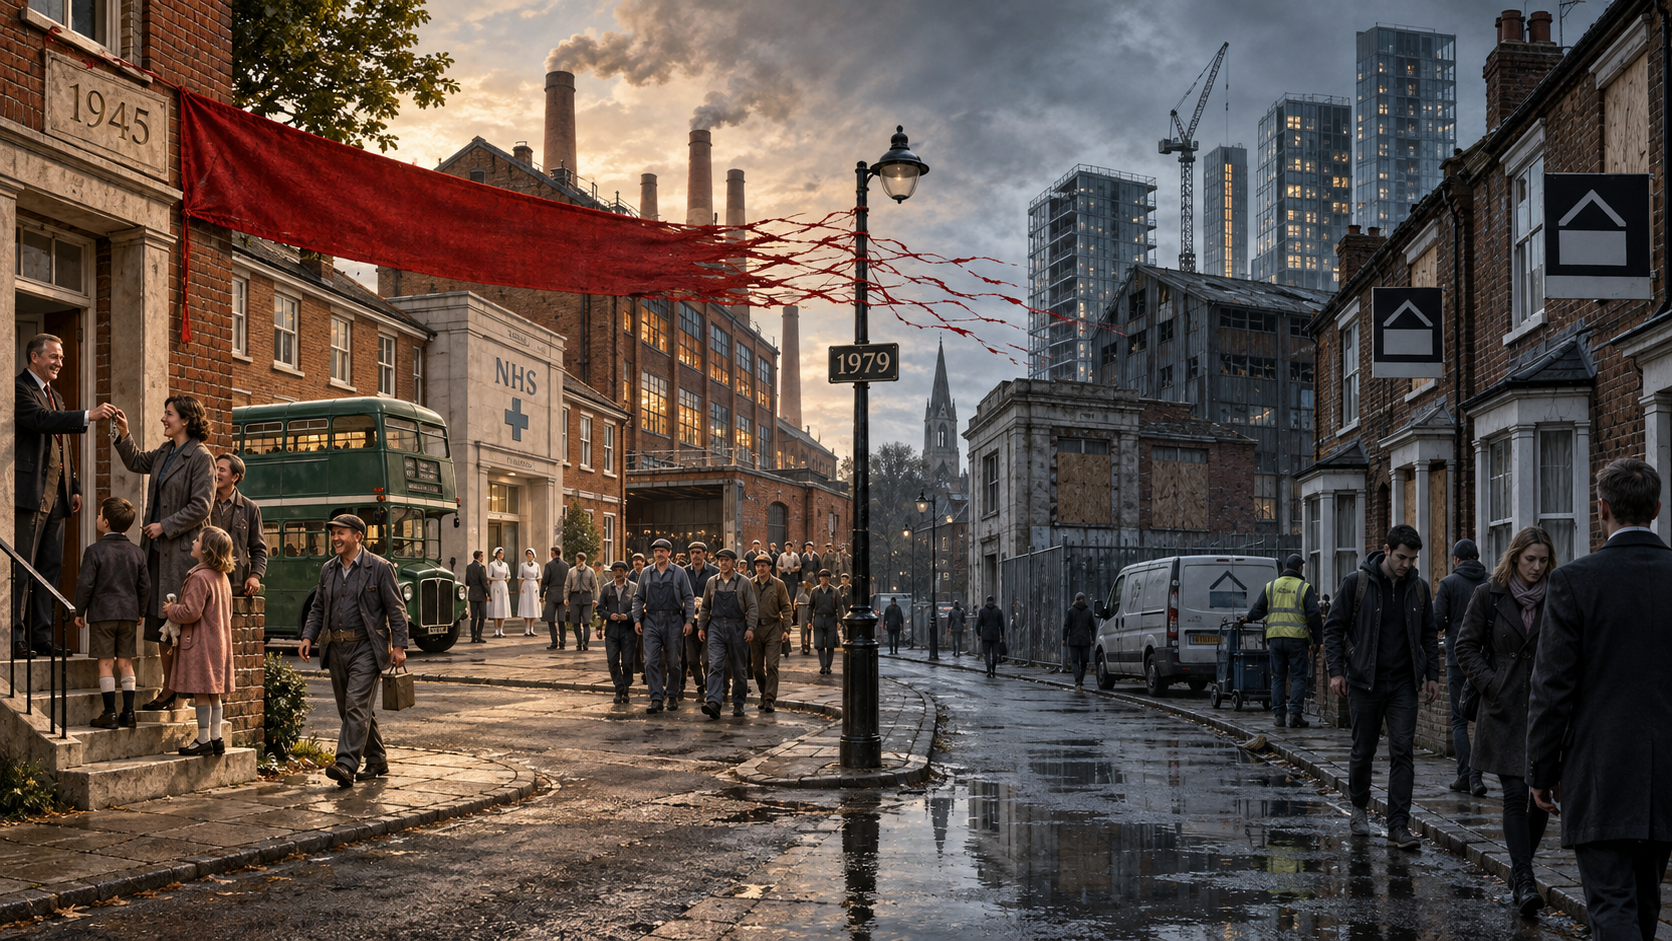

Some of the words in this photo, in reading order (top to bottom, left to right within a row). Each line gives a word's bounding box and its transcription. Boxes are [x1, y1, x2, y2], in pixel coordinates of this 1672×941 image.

[69, 83, 149, 145] 1945
[495, 356, 537, 396] NHS
[837, 351, 890, 375] 1979
